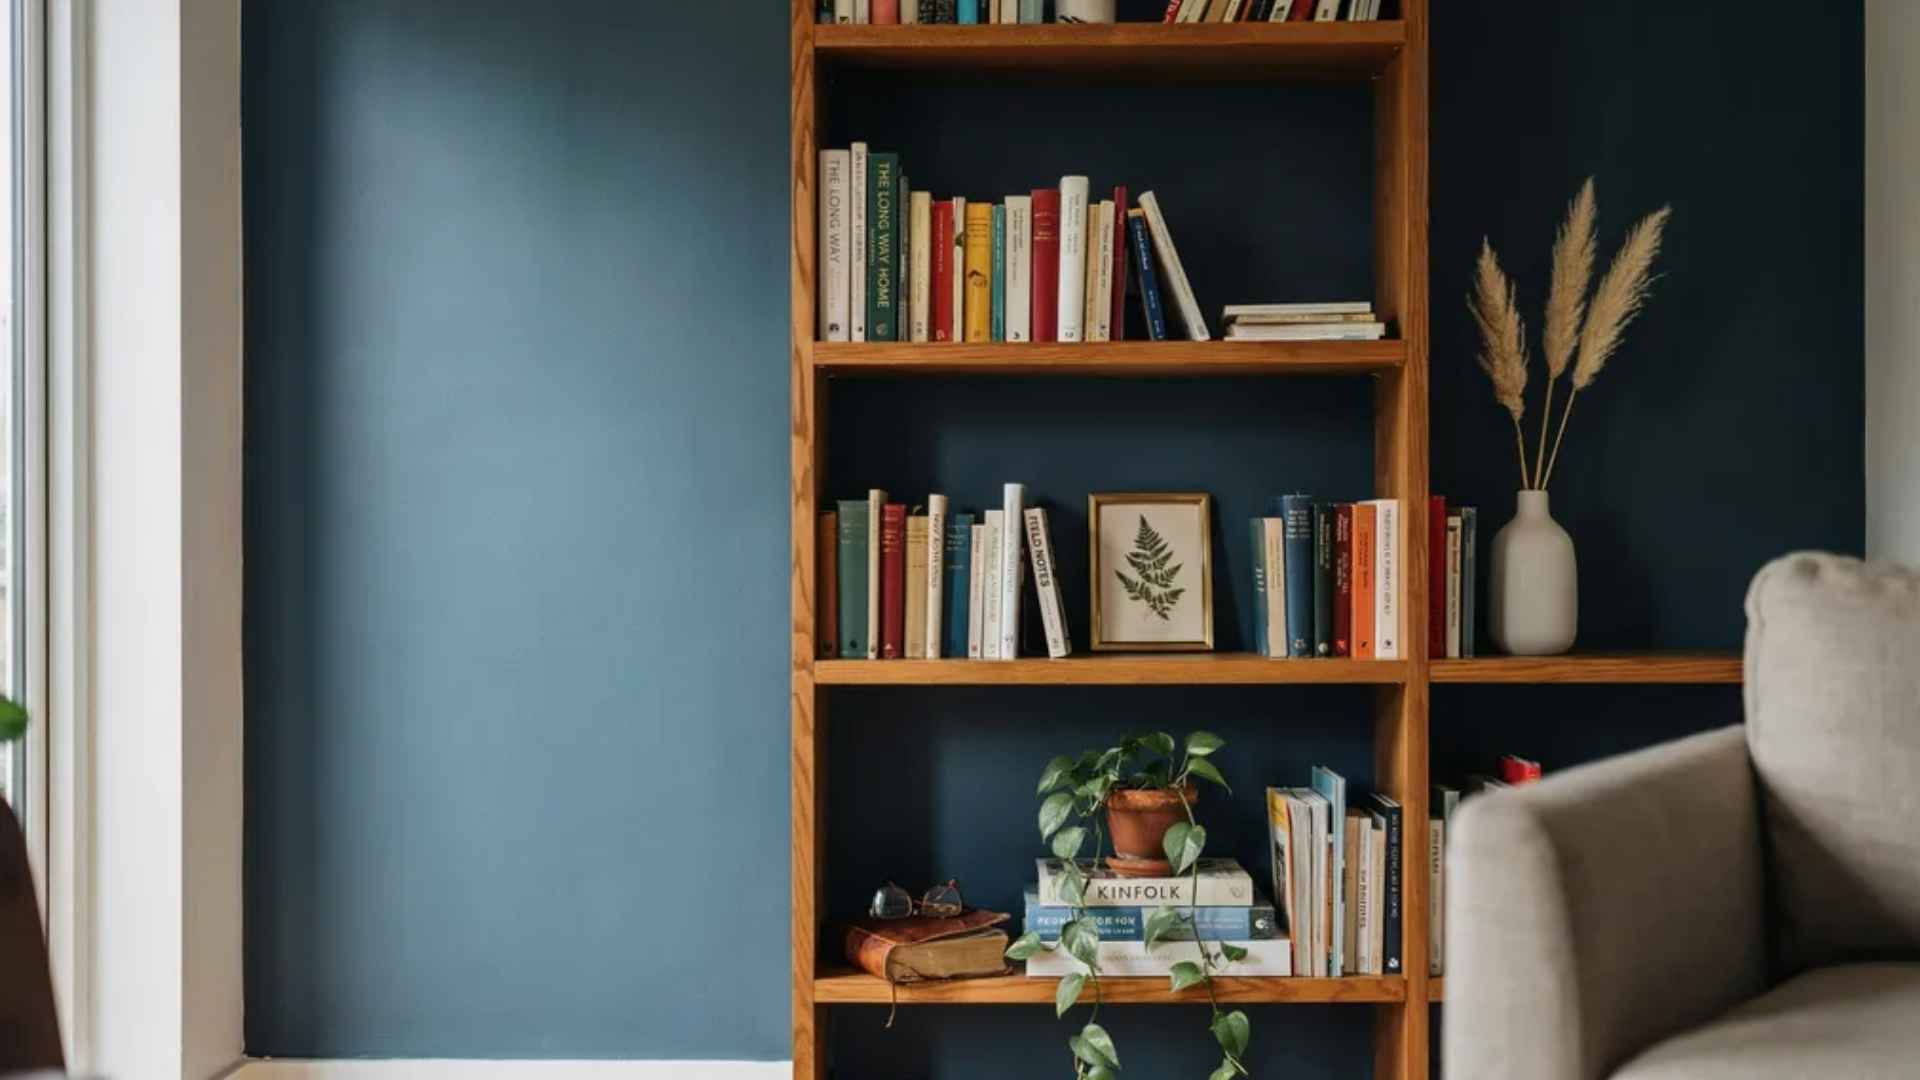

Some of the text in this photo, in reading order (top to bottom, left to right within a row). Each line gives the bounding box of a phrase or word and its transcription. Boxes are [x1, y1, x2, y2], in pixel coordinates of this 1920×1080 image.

[829, 160, 840, 184] THE
[829, 189, 840, 229] LONG
[828, 233, 840, 264] WAY
[877, 162, 890, 308] THE LONG WAY HOME
[1028, 515, 1043, 548] FIELD
[1035, 549, 1050, 588] NOTES
[1097, 885, 1181, 900] KINFOLK
